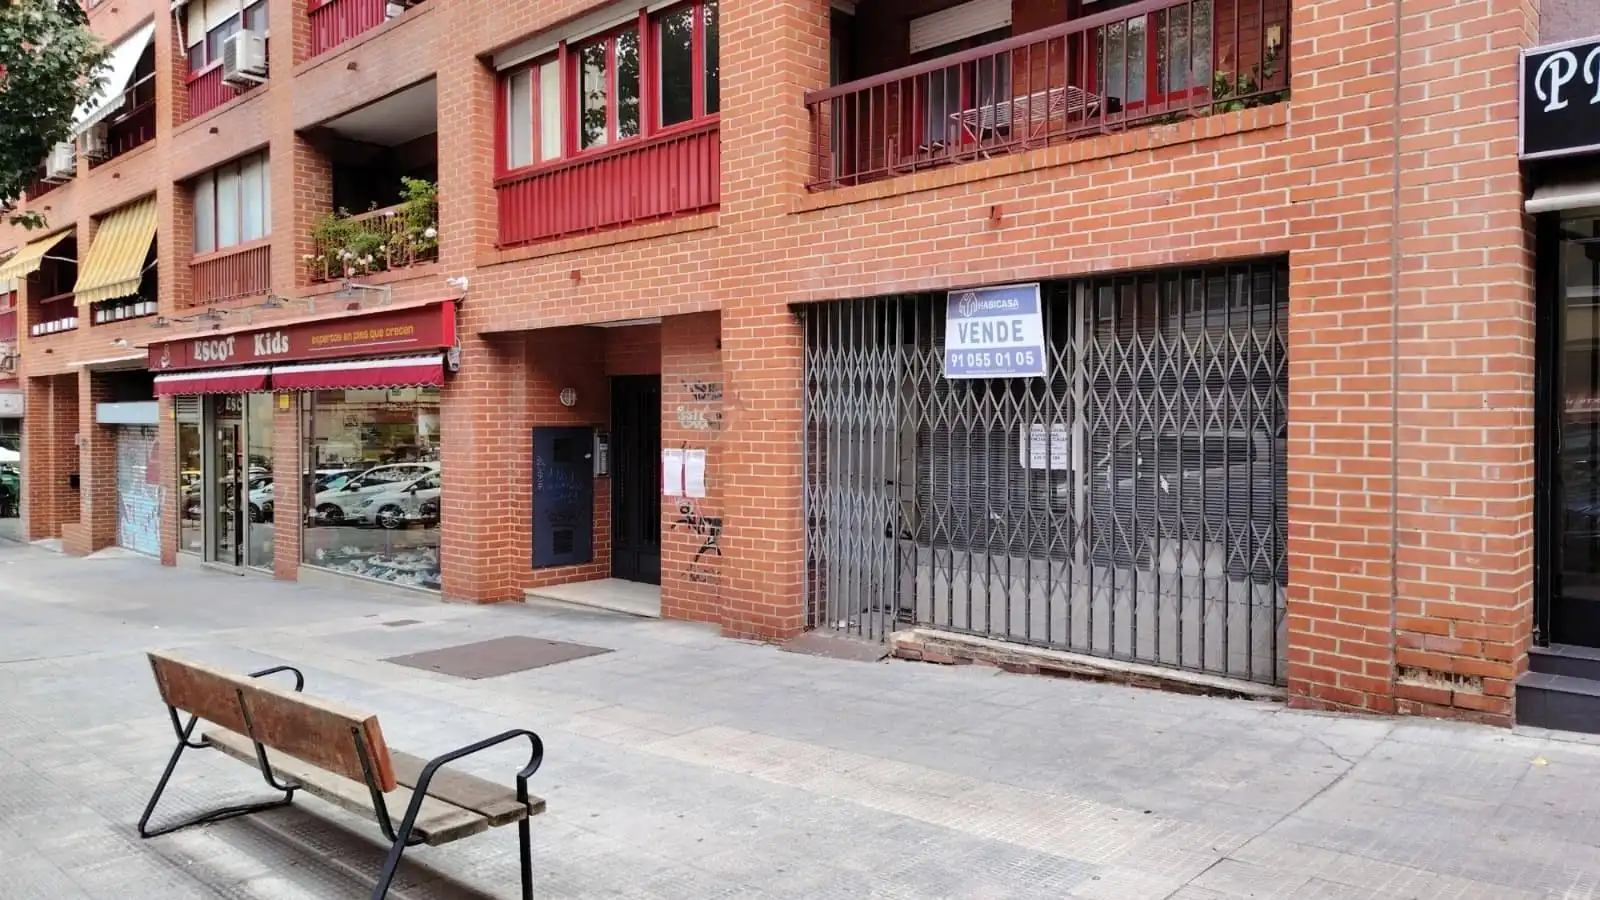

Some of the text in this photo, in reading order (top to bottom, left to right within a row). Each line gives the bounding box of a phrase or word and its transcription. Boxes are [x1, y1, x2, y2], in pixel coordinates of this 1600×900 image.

[370, 327, 384, 340] que
[958, 320, 1024, 344] VENDE
[194, 331, 288, 361] ESCOT Kids
[951, 351, 1034, 367] 91 055 01 05
